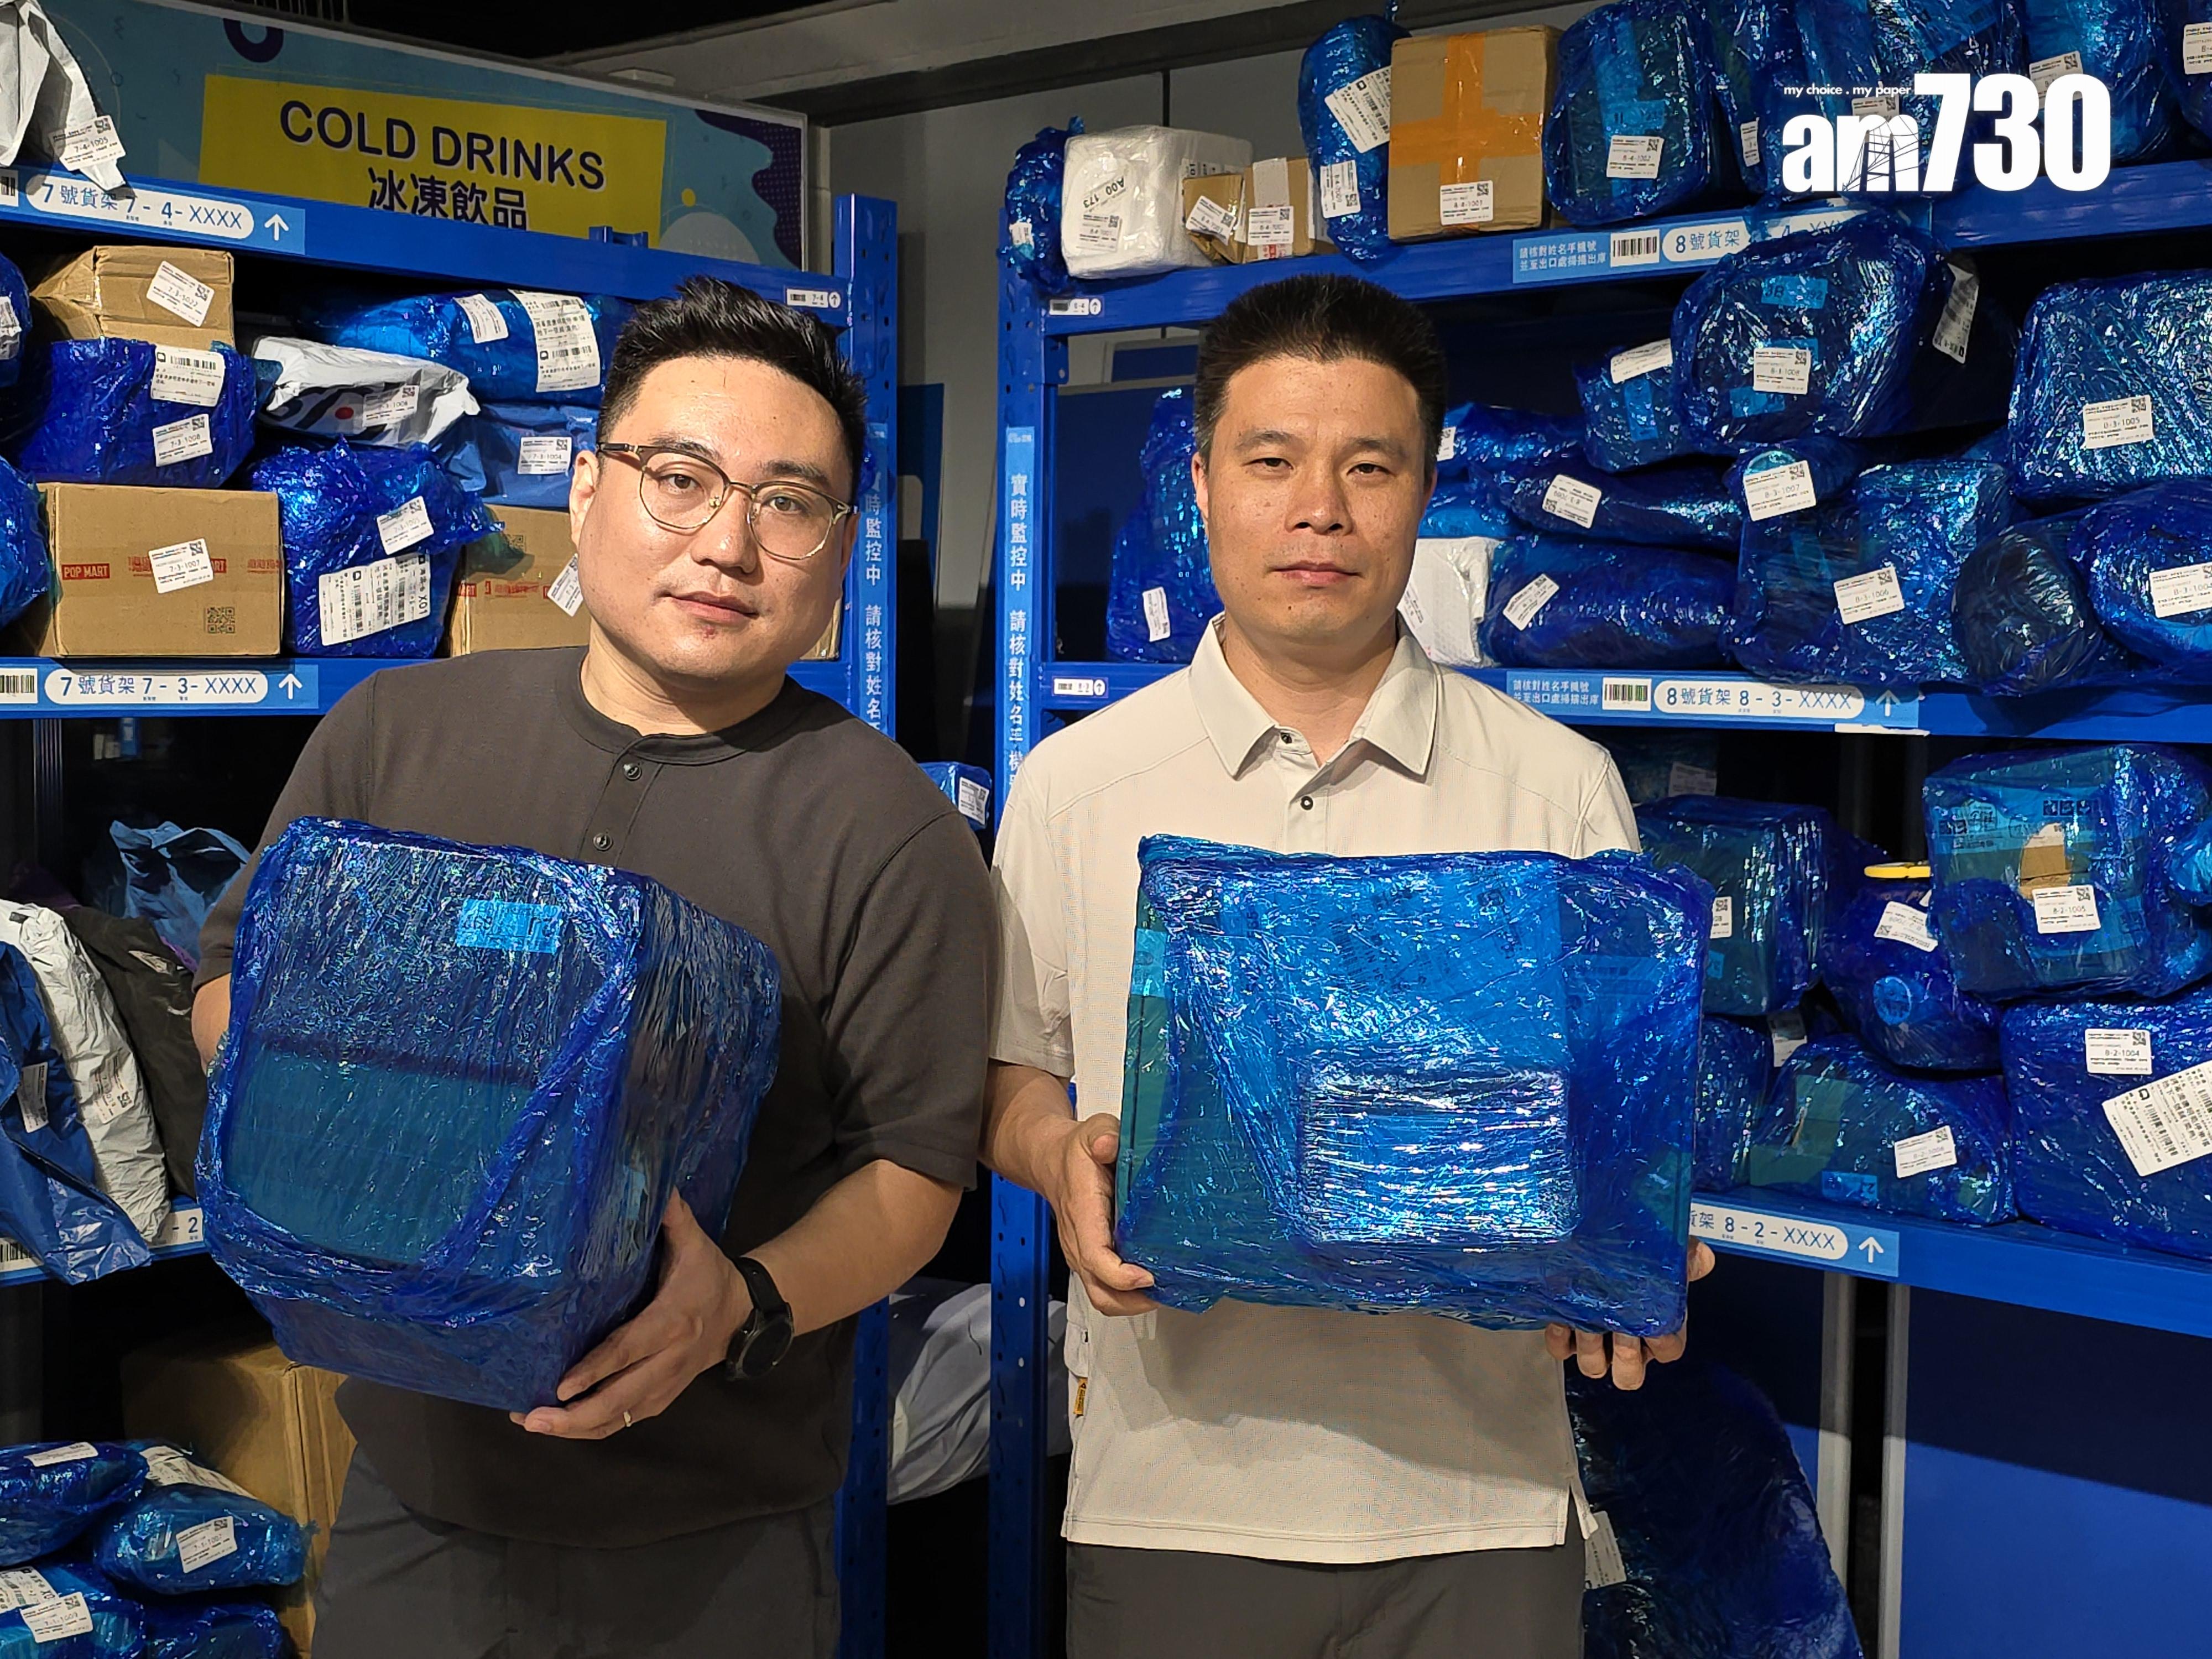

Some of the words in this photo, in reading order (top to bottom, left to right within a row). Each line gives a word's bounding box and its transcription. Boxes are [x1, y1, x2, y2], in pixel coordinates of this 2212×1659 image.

[280, 101, 416, 158] COLD
[432, 126, 605, 191] DRINKS
[368, 167, 528, 231] 冰凍飲品
[865, 472, 881, 586] 時監控中
[1010, 473, 1027, 591] 實時監控中
[64, 566, 81, 578] POP
[83, 564, 108, 576] MART
[60, 676, 135, 697] 7號貨架
[1667, 687, 1731, 706] 8號貨架
